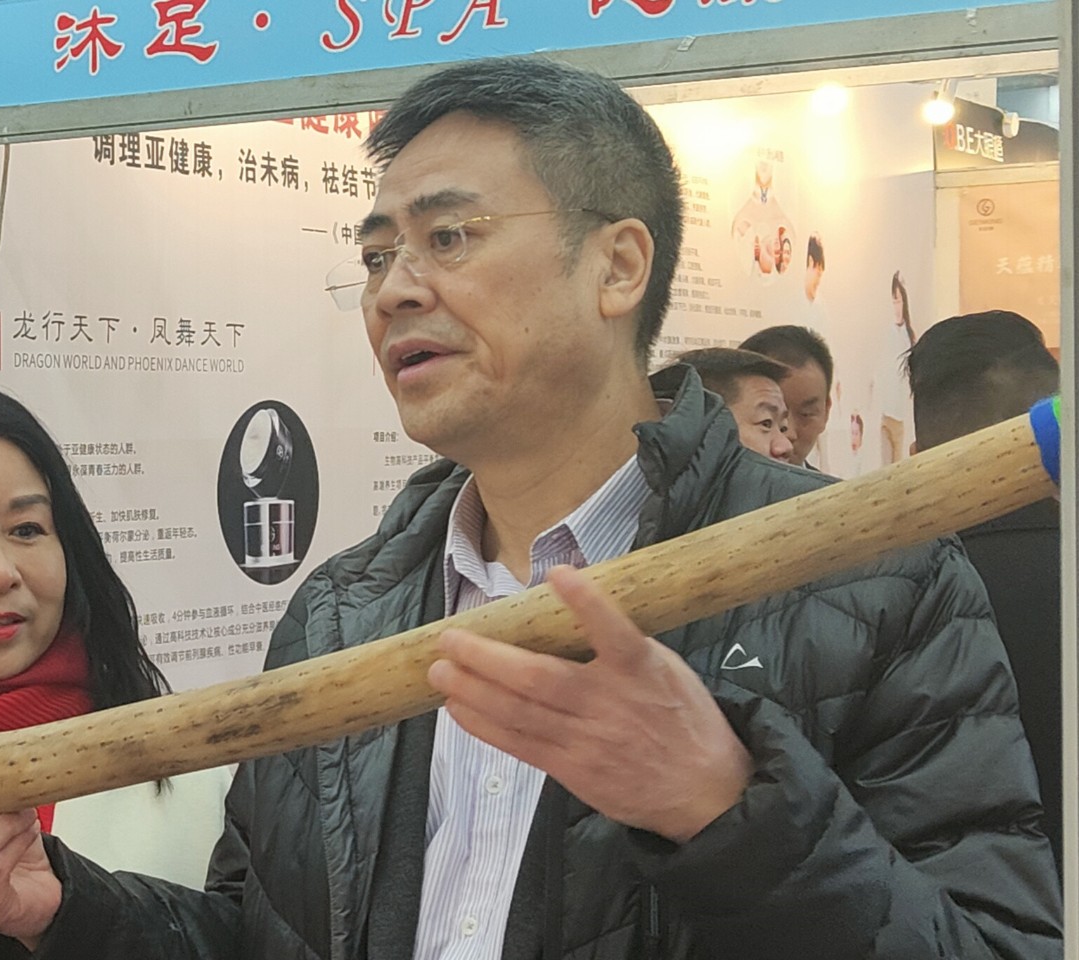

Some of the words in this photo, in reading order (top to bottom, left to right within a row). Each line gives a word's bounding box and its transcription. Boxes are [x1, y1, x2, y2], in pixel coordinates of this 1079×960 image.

[13, 352, 61, 369] DRAGON
[63, 353, 102, 370] WORLD
[103, 355, 126, 370] AND
[127, 356, 174, 372] PHOENIX
[175, 357, 208, 372] DANCE
[209, 358, 245, 373] WORLD
